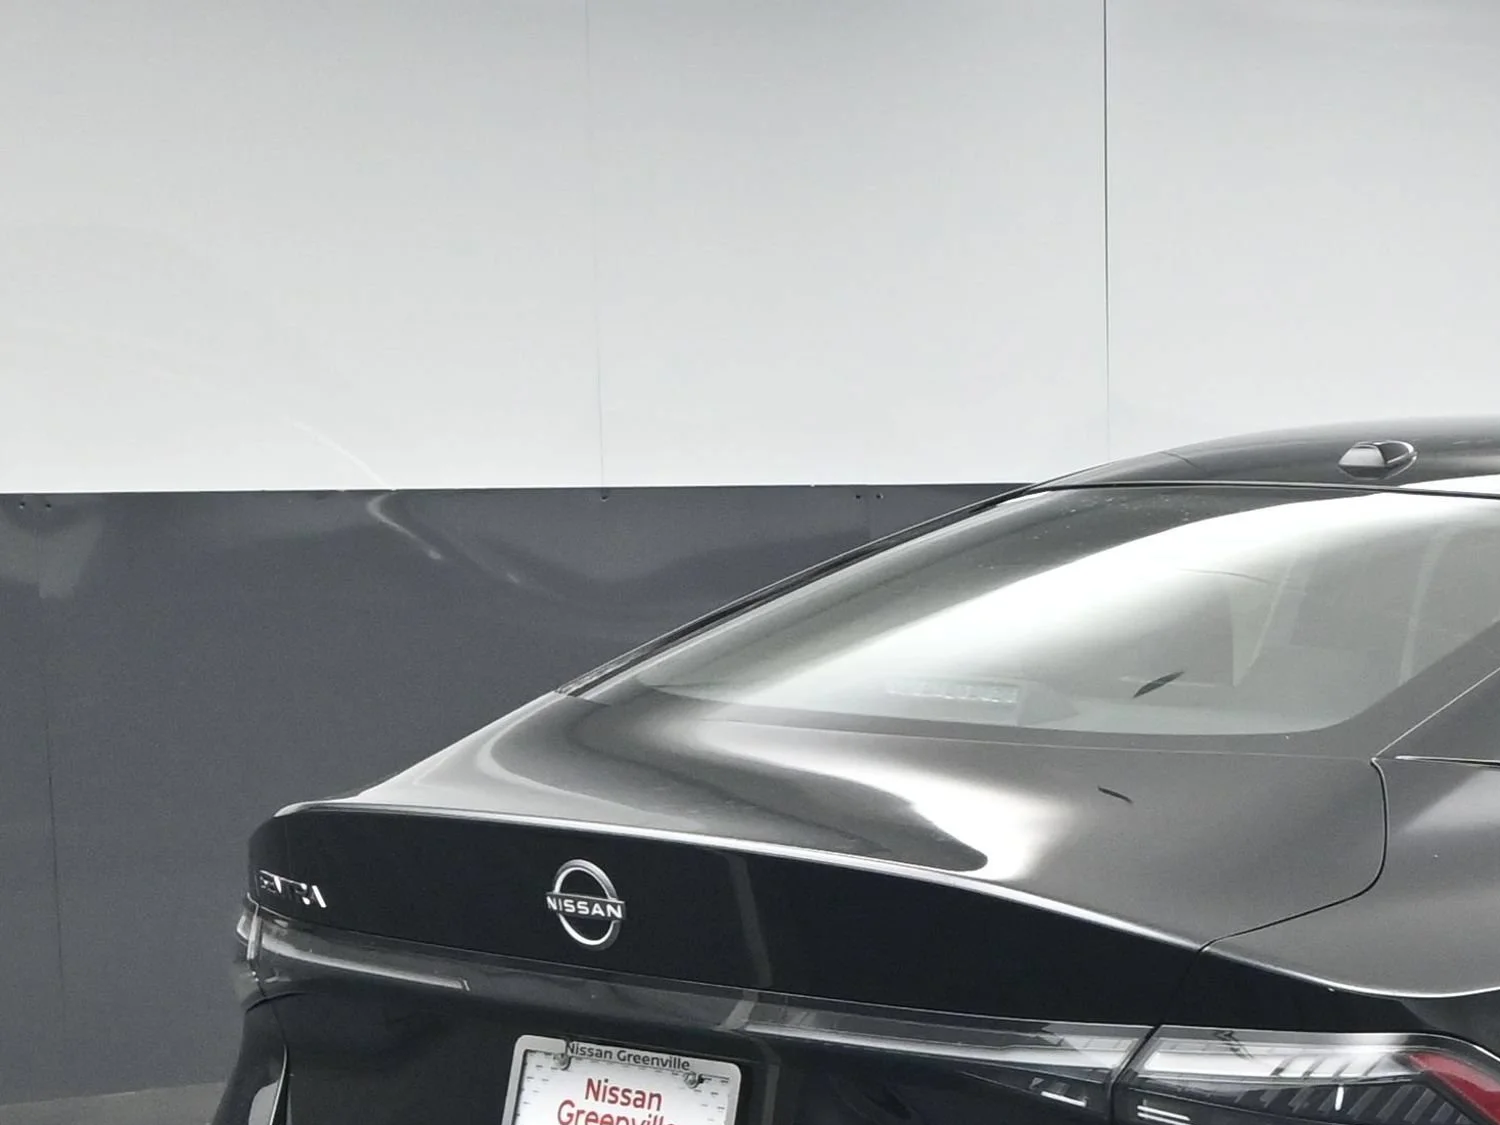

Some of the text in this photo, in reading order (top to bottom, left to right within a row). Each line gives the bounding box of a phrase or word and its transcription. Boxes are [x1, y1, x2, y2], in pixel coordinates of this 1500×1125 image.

[545, 895, 623, 919] NISSAN
[565, 1042, 691, 1071] Nissan Greenville
[584, 1078, 663, 1112] Nissan
